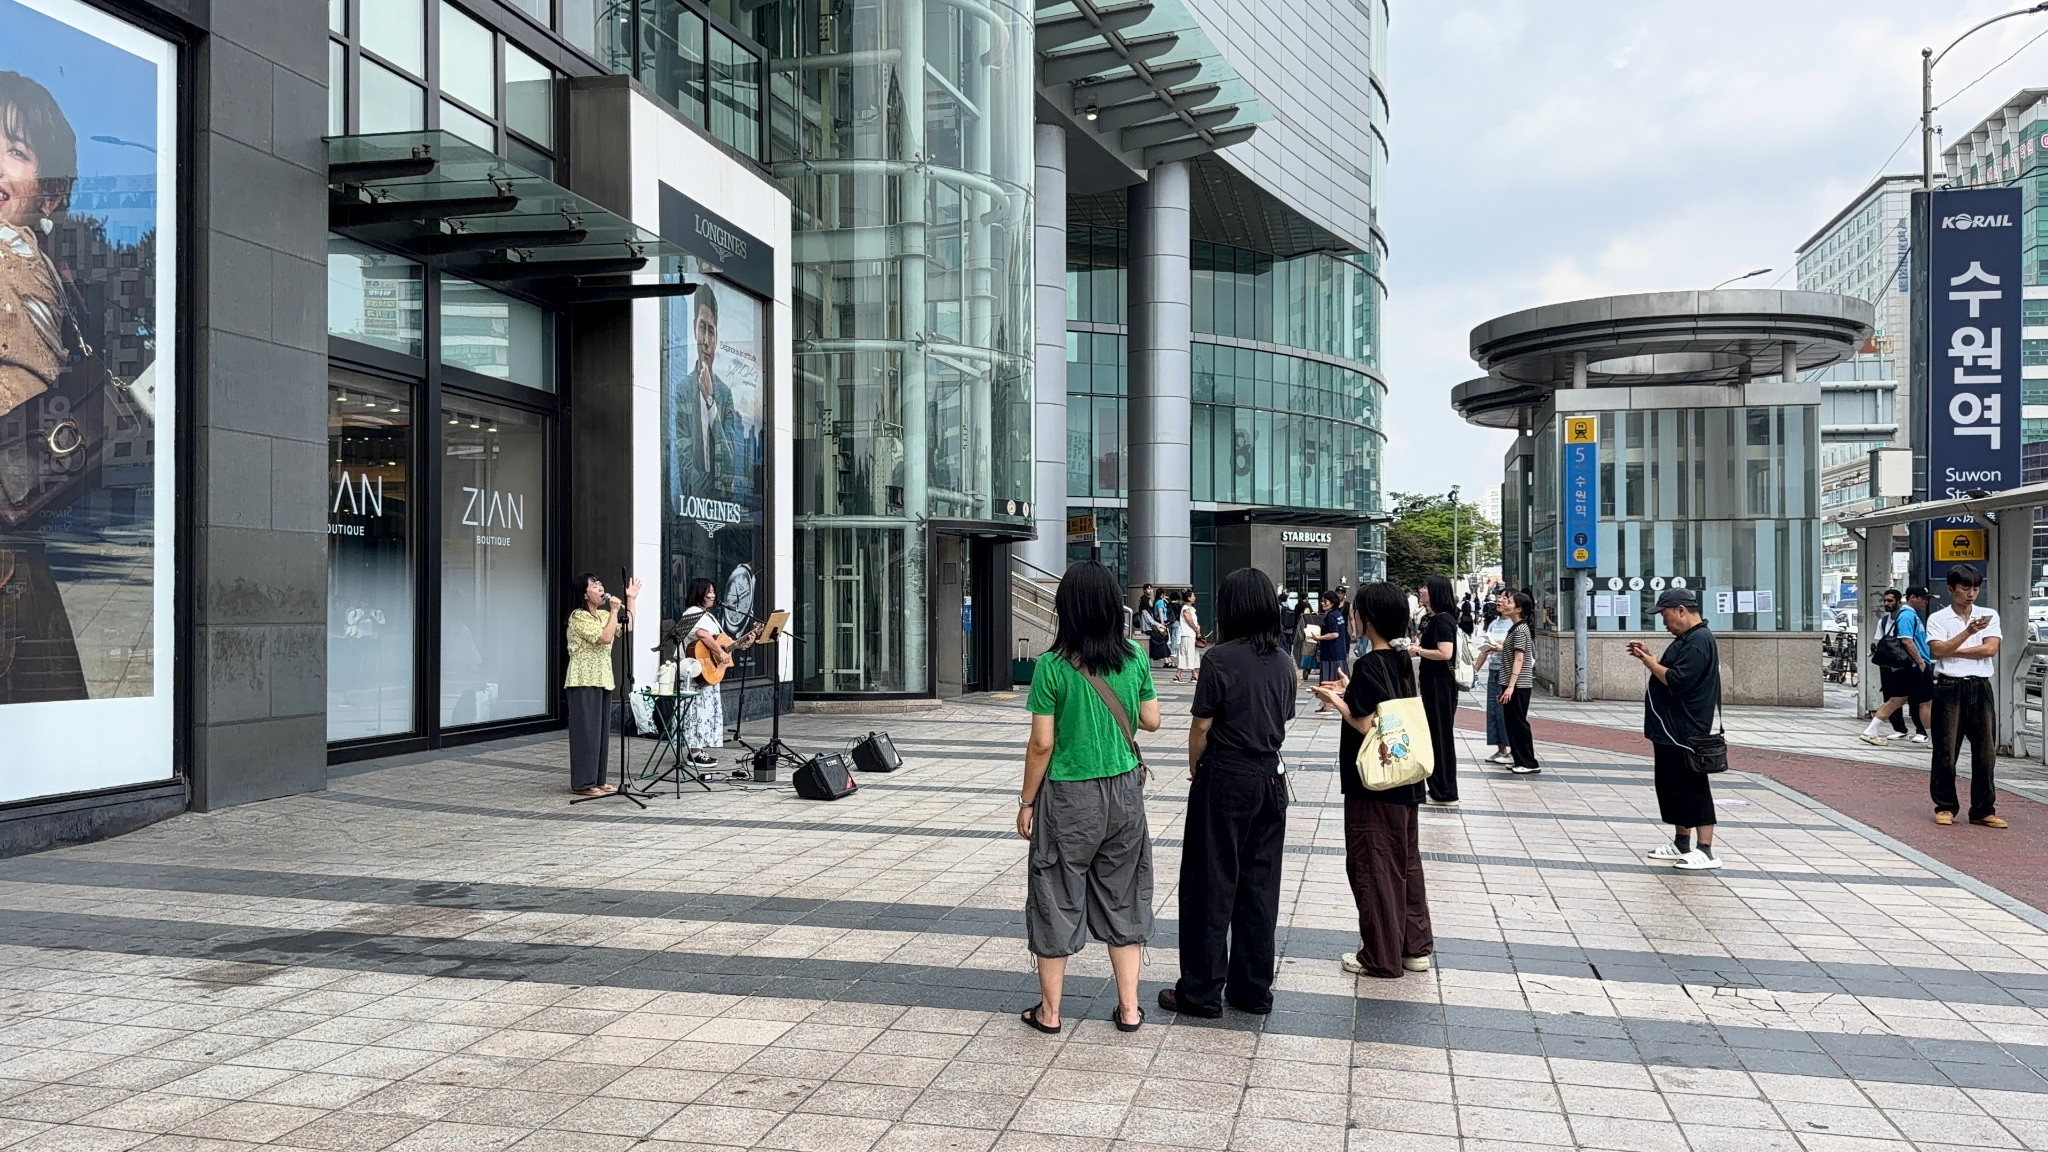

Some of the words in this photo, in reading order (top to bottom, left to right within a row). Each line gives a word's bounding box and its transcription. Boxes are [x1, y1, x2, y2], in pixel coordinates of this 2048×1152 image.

[1942, 213, 2013, 230] KORAIL
[695, 214, 747, 259] LONGINES
[1947, 261, 2002, 450] 수원역
[1575, 447, 1586, 463] 5
[1945, 467, 2001, 482] Suwon
[333, 470, 382, 517] AN
[1575, 475, 1587, 517] 수원역
[462, 486, 524, 530] ZIAN
[680, 495, 741, 524] LONGINES
[328, 523, 365, 536] OUTIQUE
[476, 535, 511, 547] BOUTIQUE
[1282, 530, 1332, 543] STARBUCKS
